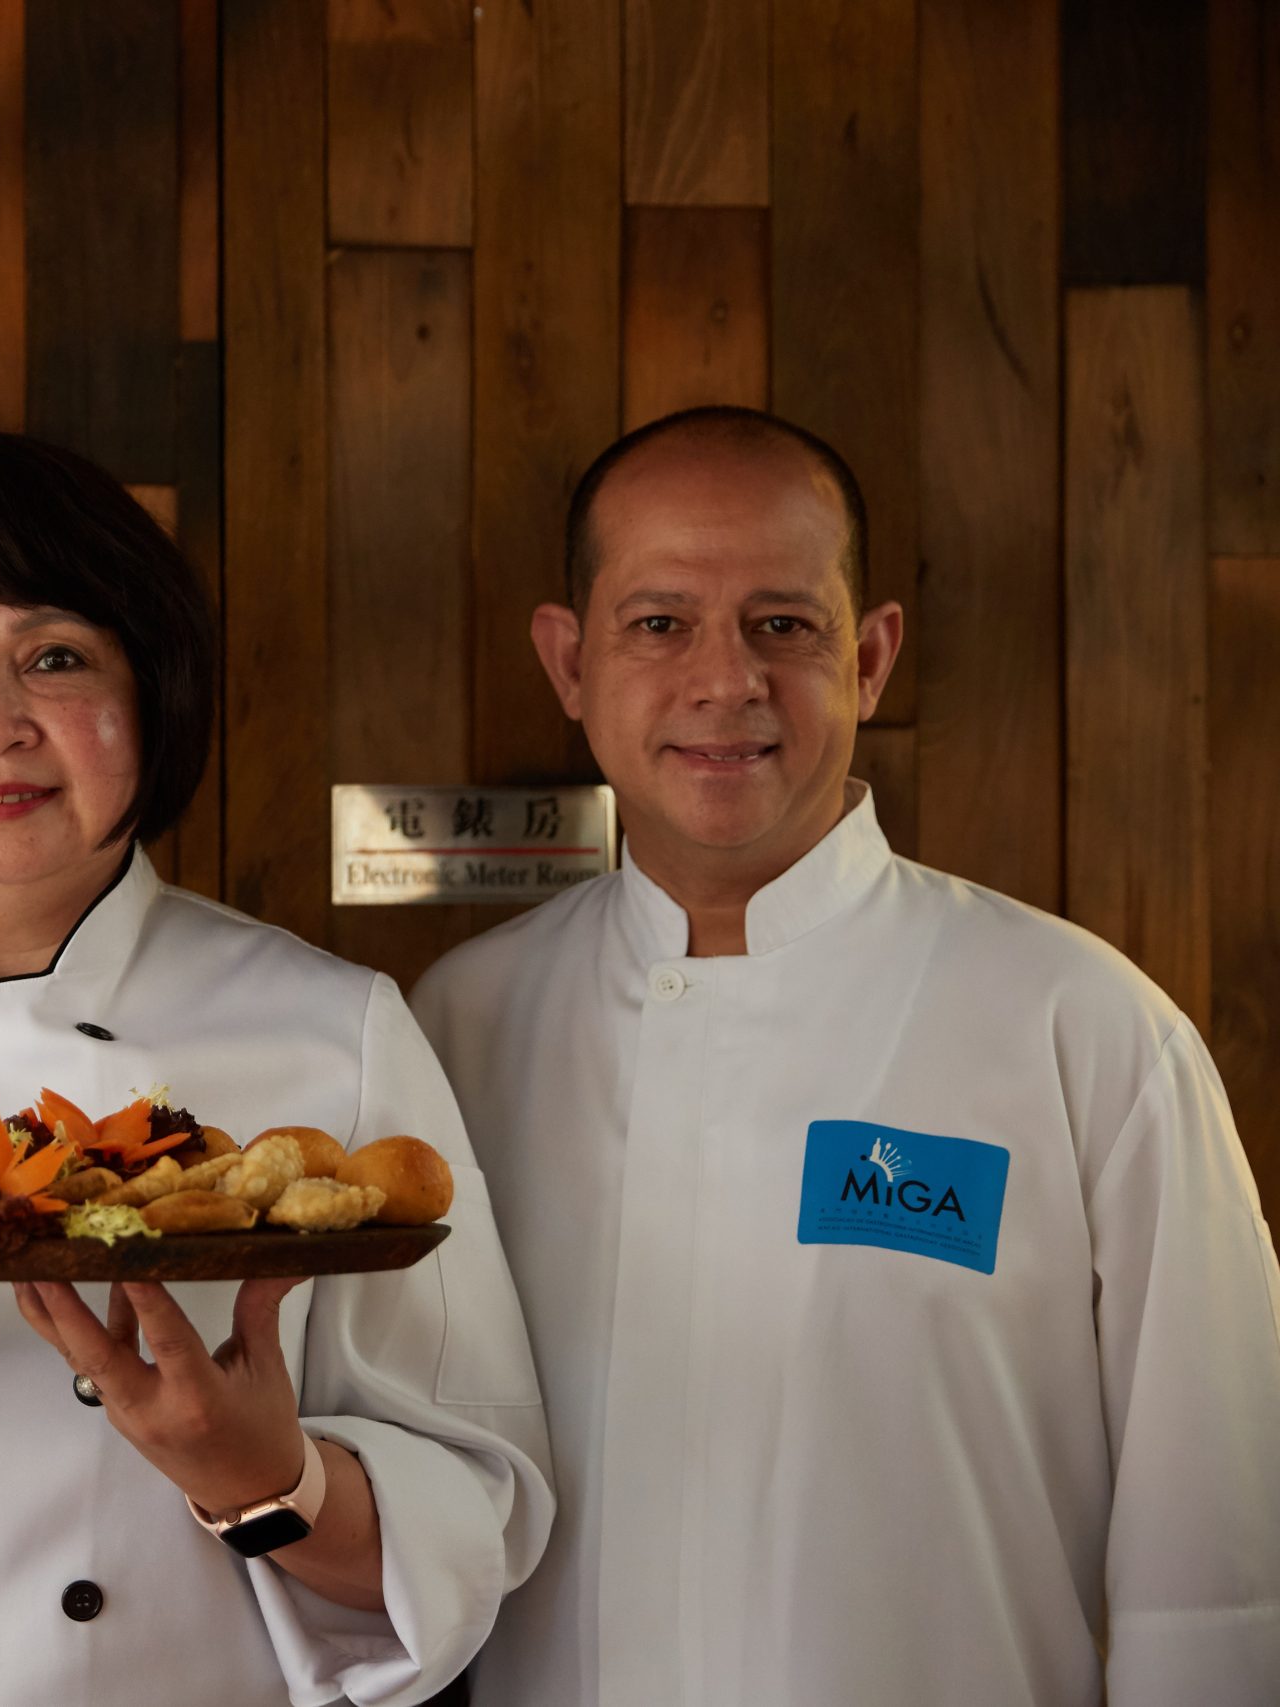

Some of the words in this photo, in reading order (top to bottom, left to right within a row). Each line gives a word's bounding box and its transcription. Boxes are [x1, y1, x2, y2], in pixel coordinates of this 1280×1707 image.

[384, 796, 562, 839] 電錶房
[347, 862, 457, 886] Electronic
[465, 862, 527, 886] Meter
